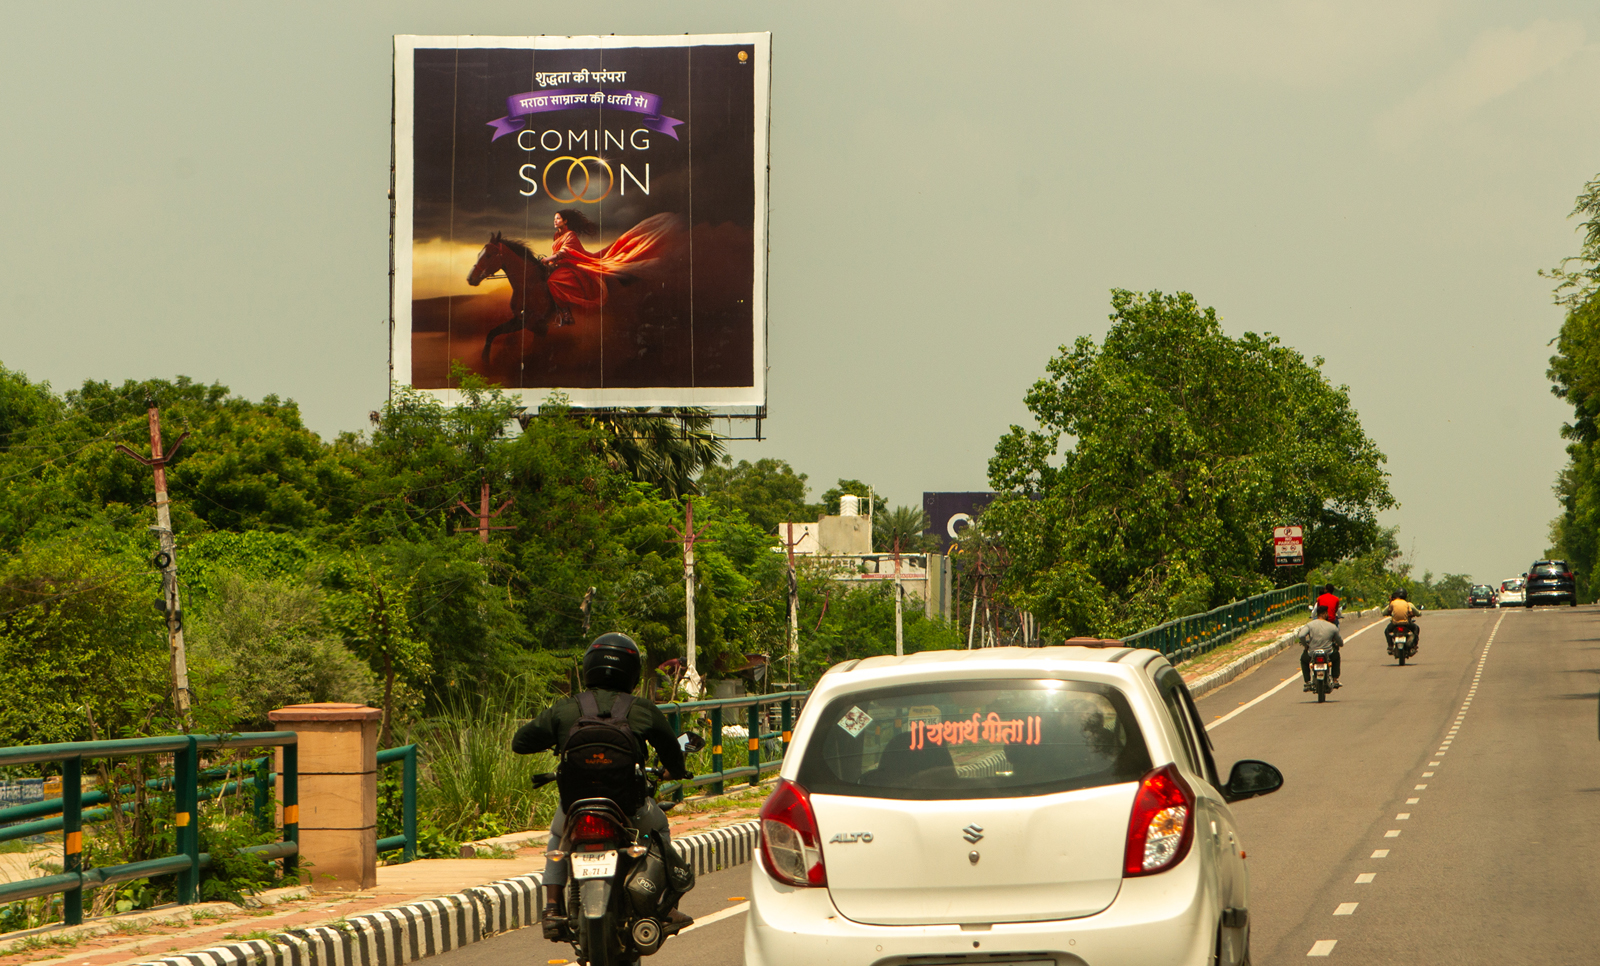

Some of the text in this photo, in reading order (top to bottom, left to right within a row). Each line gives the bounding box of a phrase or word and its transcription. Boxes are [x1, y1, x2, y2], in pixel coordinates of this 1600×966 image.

[535, 68, 626, 87] शुद्धता की परंपरा
[519, 96, 548, 108] मराठा
[550, 93, 588, 105] साम्राज्य
[589, 91, 605, 104] की
[607, 93, 633, 106] धरती
[517, 128, 650, 151] COMING
[518, 155, 650, 204] SOON
[829, 831, 874, 844] ALTO
